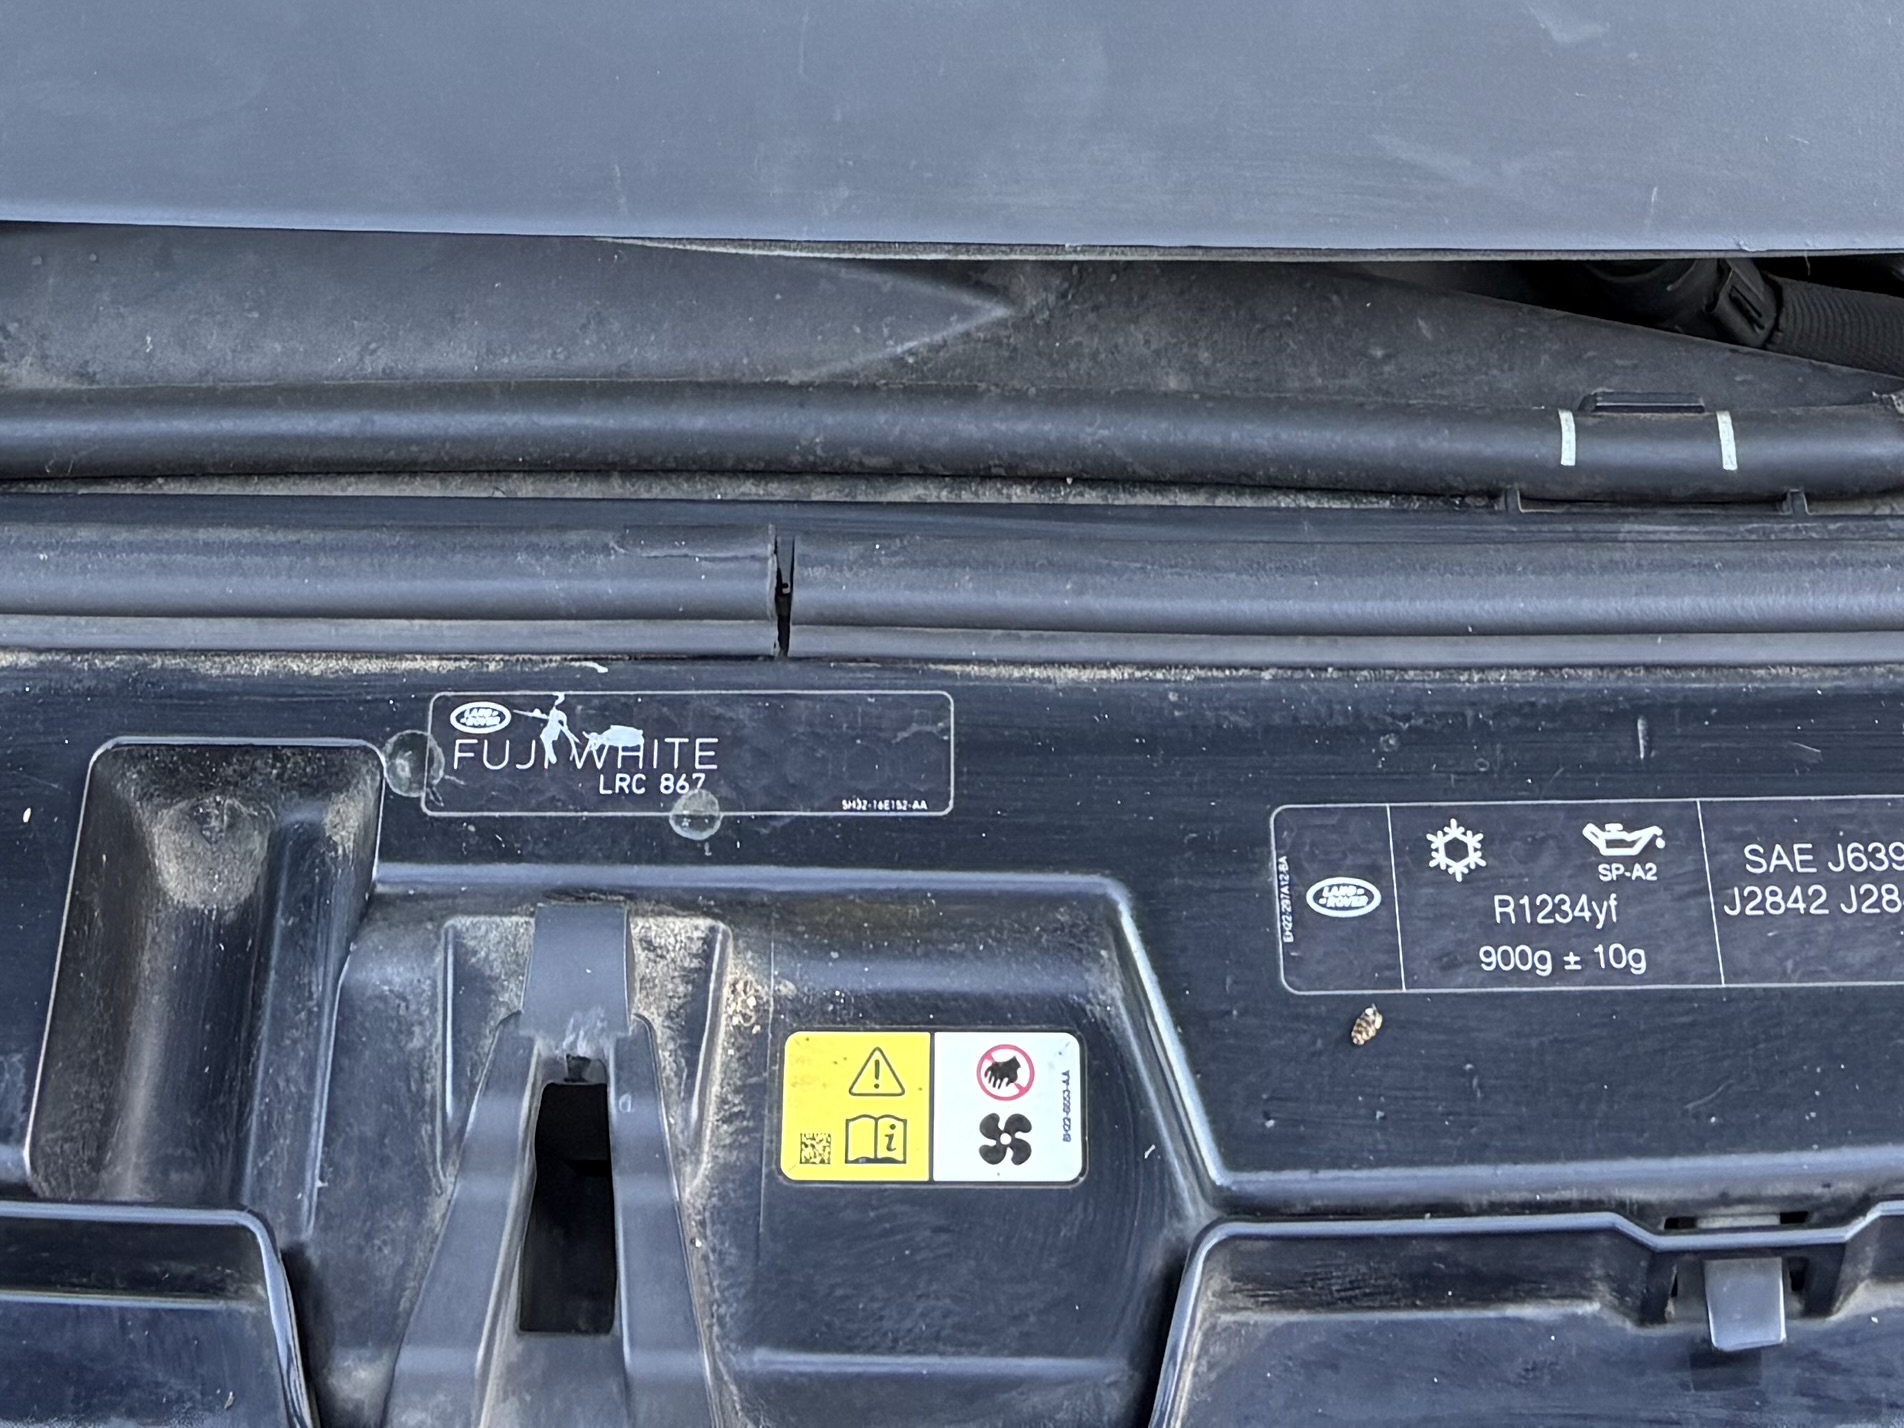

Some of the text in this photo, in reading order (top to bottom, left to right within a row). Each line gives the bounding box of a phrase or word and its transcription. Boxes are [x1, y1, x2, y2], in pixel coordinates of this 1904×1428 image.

[598, 772, 706, 795] LRC 867
[1598, 862, 1658, 882] SP-A2
[1743, 843, 1818, 874] SAE
[1493, 892, 1618, 930] R1234yf
[1723, 884, 1830, 916] J2842
[1478, 944, 1553, 977] 900g
[1593, 943, 1647, 976] 10g
